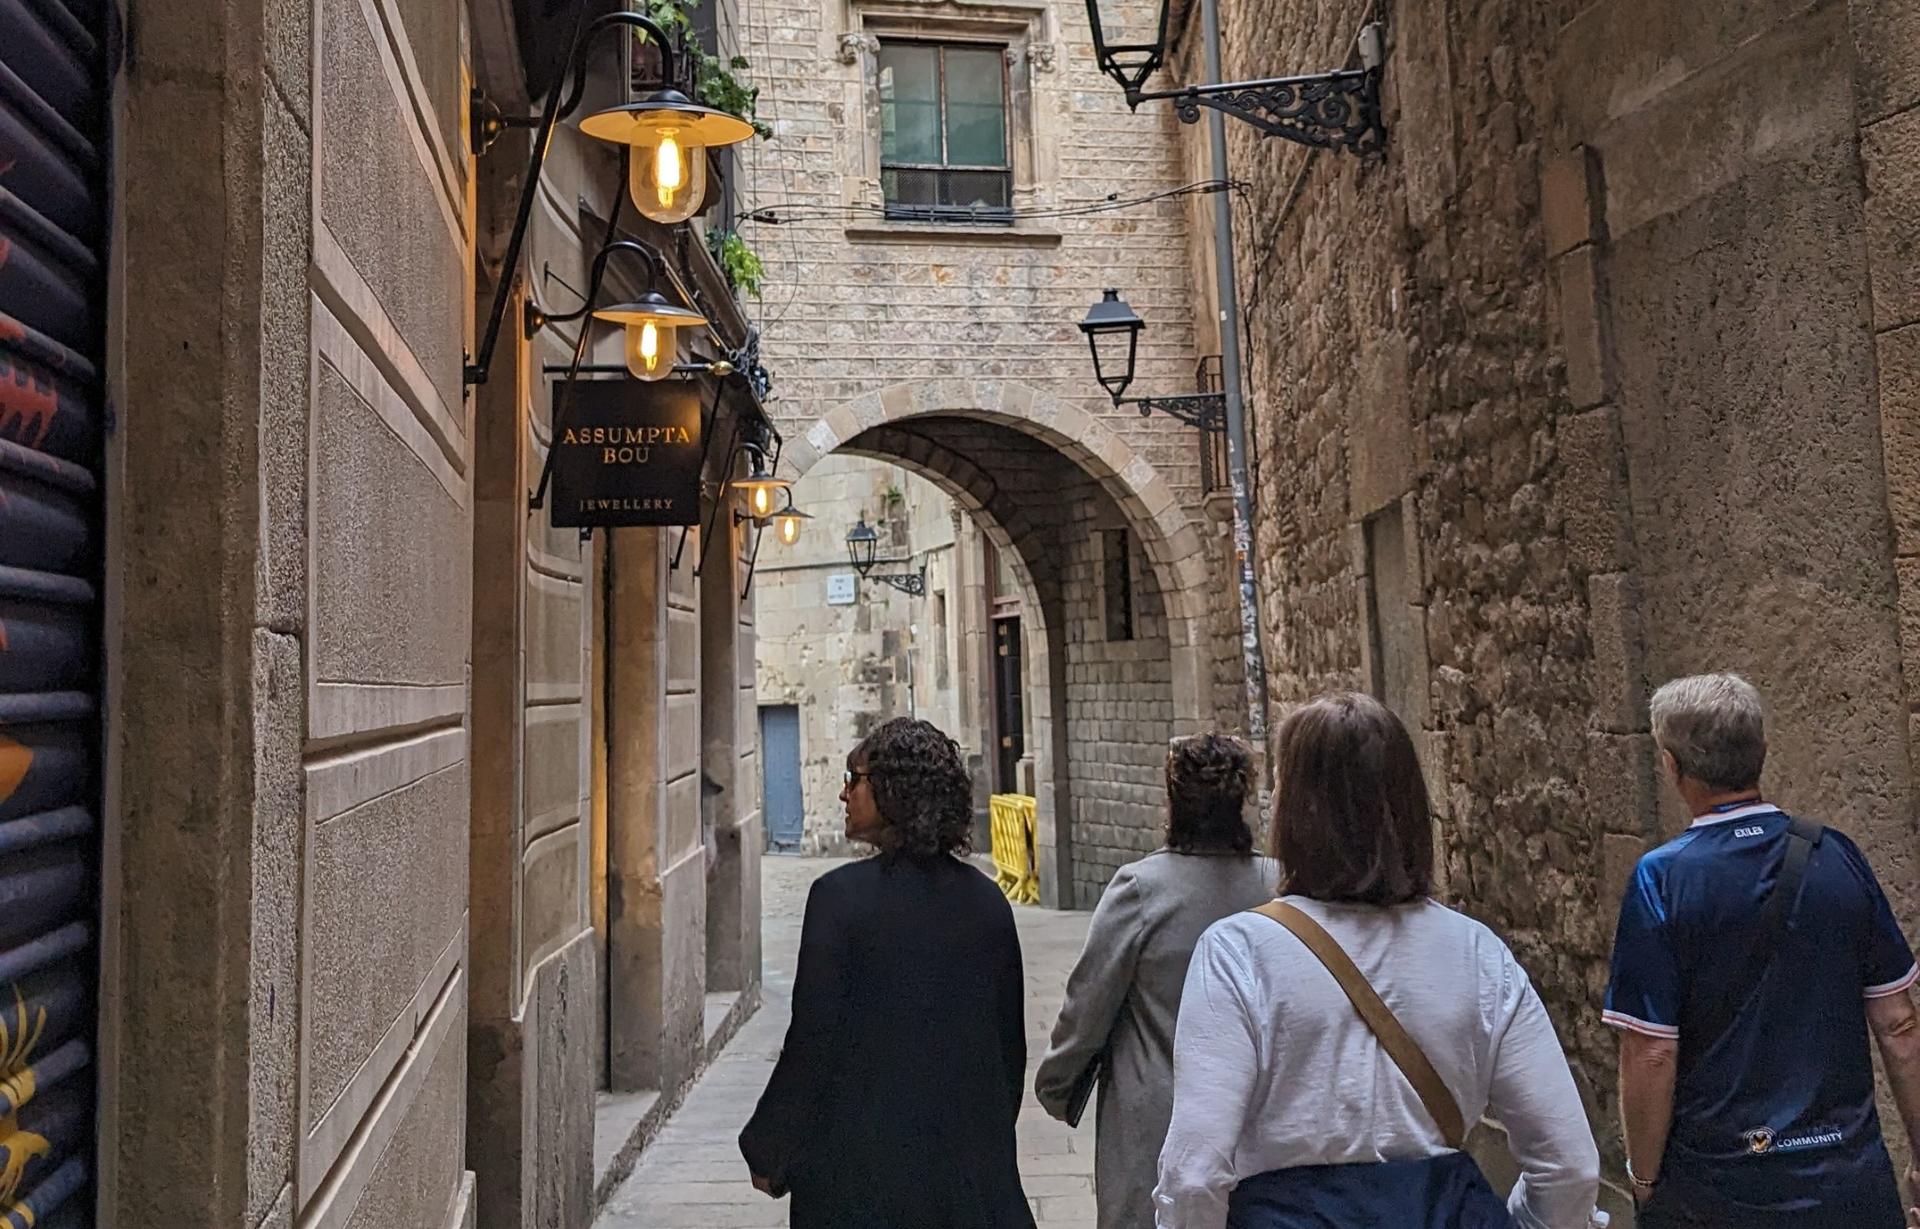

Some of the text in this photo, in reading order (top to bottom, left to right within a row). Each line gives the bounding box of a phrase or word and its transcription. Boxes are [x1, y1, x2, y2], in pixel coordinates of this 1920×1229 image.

[563, 427, 690, 444] ASSUMPTA
[603, 448, 650, 464] BOU
[579, 499, 673, 512] JEWELLERY
[1776, 1132, 1842, 1148] COMMUNITY
